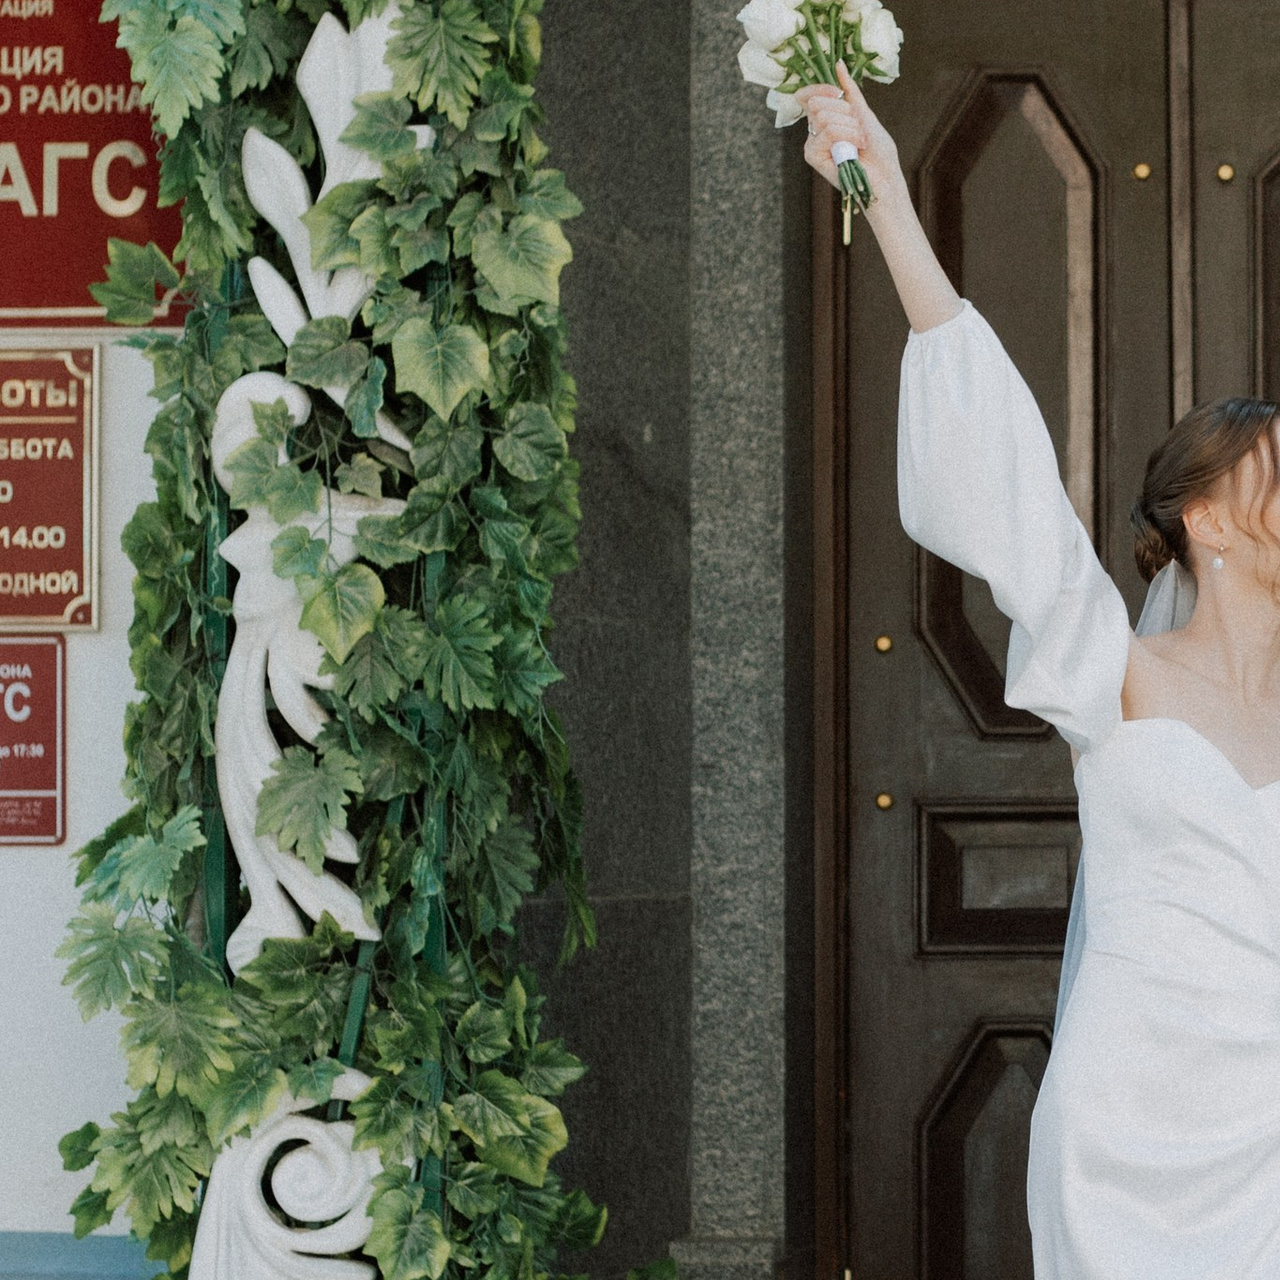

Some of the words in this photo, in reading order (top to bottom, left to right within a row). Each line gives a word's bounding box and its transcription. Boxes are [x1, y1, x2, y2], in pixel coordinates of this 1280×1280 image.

[0, 140, 148, 218] АГС
[1, 379, 77, 408] ОТЫ
[0, 525, 66, 550] 14.00
